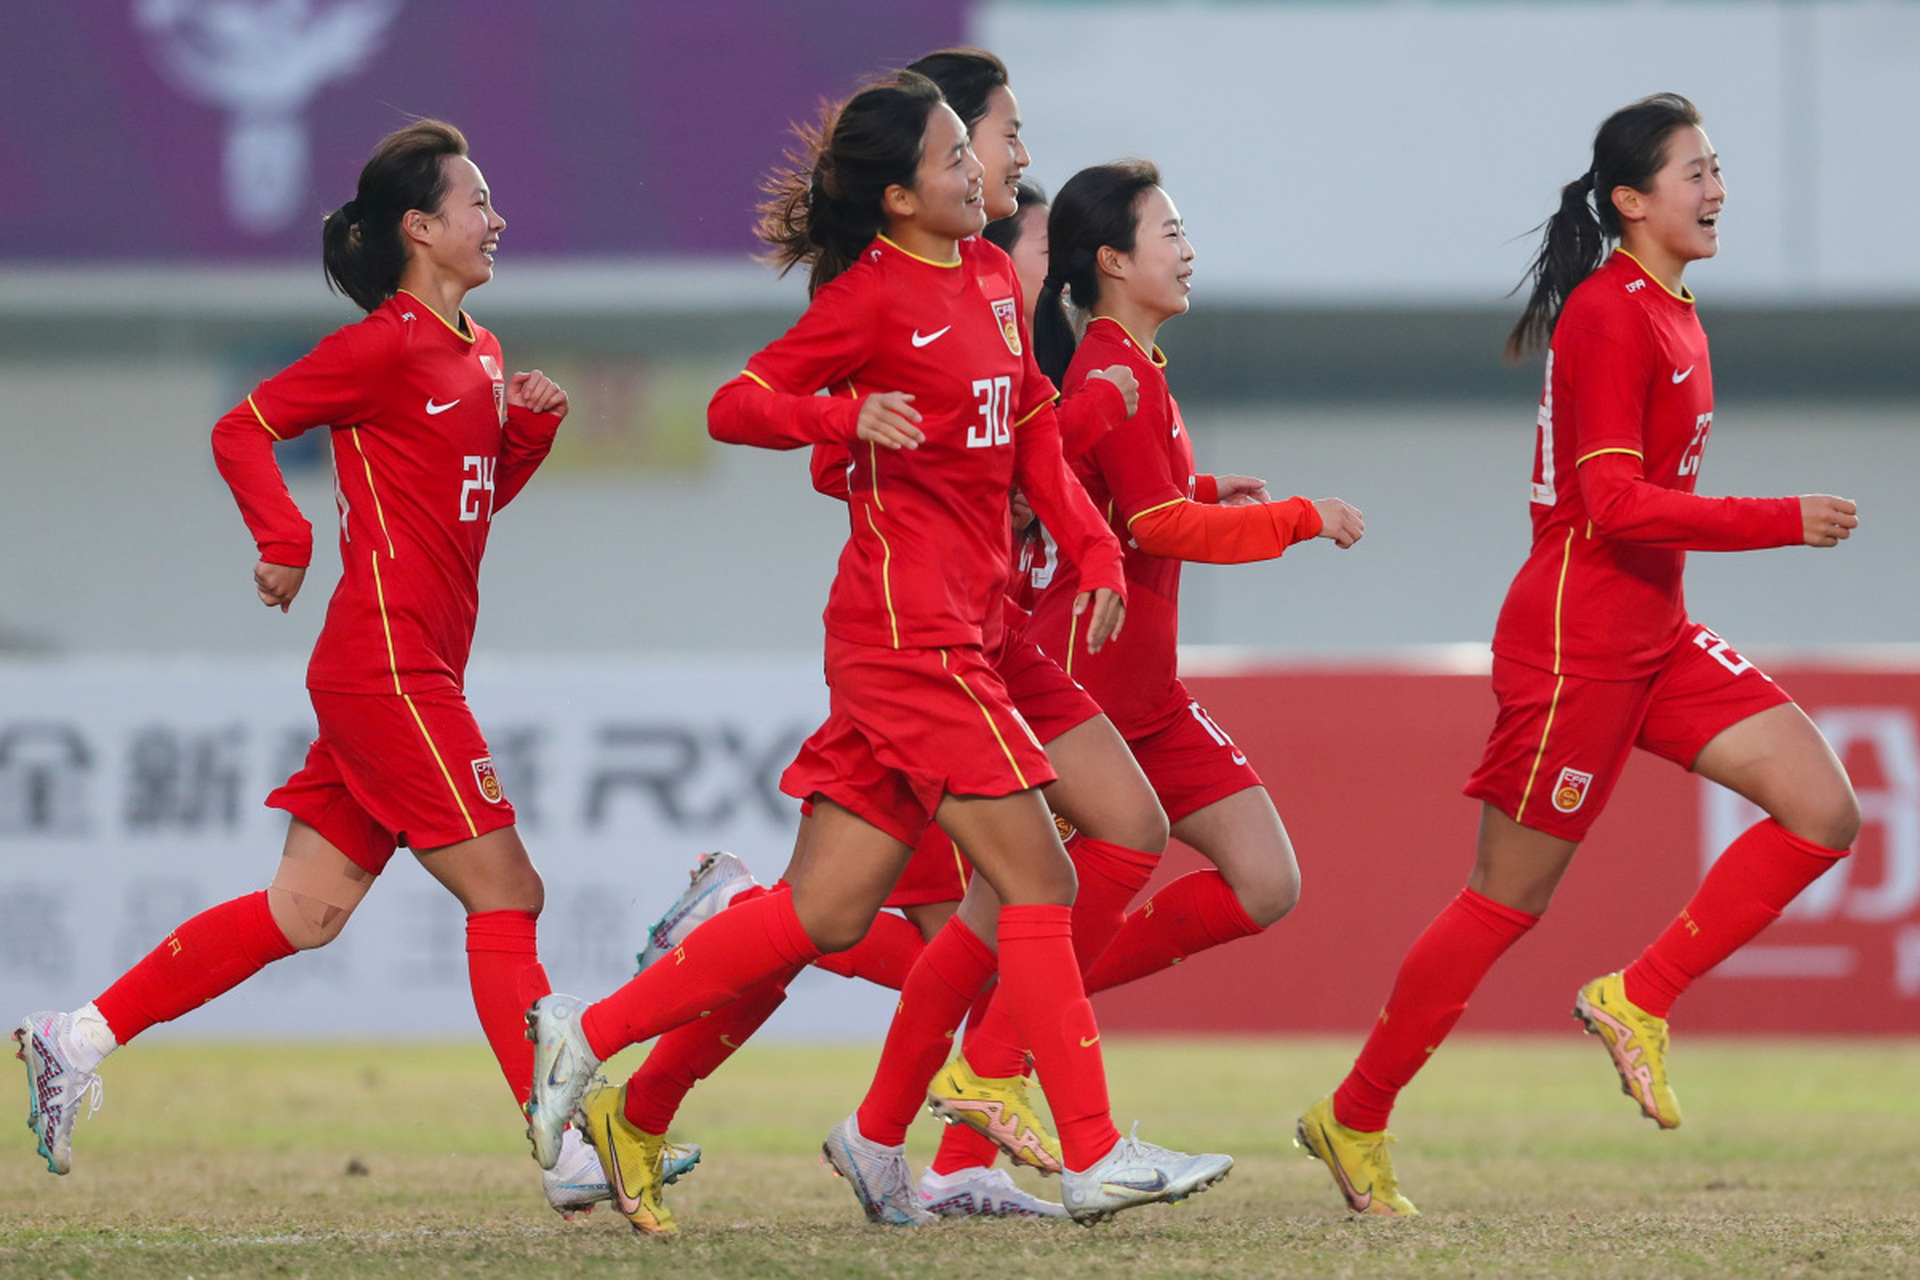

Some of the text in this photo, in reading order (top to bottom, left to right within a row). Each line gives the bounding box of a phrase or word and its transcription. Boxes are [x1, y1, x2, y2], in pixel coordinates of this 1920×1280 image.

[966, 375, 1012, 449] 30
[459, 455, 498, 523] 24
[1692, 627, 1773, 683] 2
